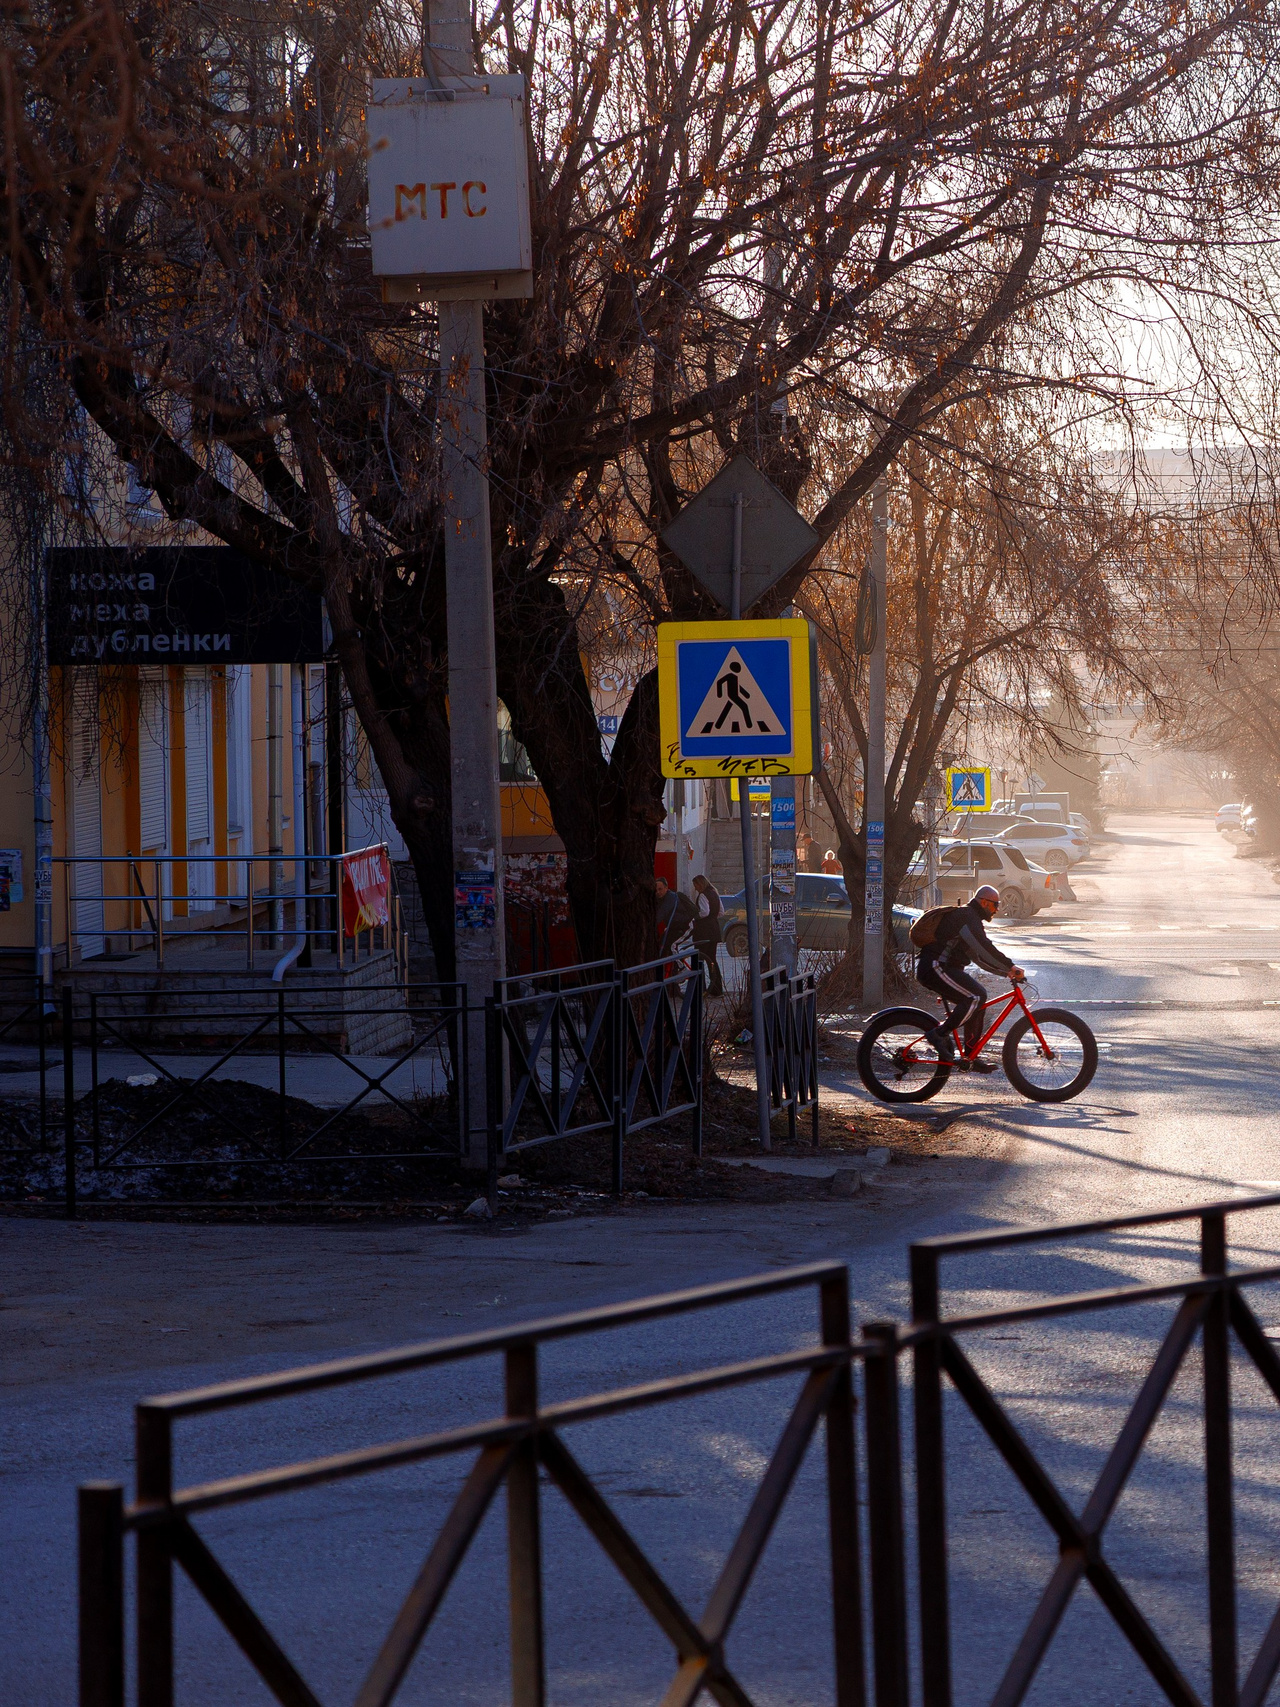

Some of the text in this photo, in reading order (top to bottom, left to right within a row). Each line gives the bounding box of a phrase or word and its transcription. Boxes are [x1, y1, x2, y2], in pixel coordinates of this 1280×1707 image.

[395, 181, 487, 220] МТС
[70, 572, 155, 591] кожа
[70, 603, 150, 621] меха
[71, 629, 230, 658] дубленки
[600, 719, 616, 731] 14
[772, 903, 794, 913] ШУБЫ
